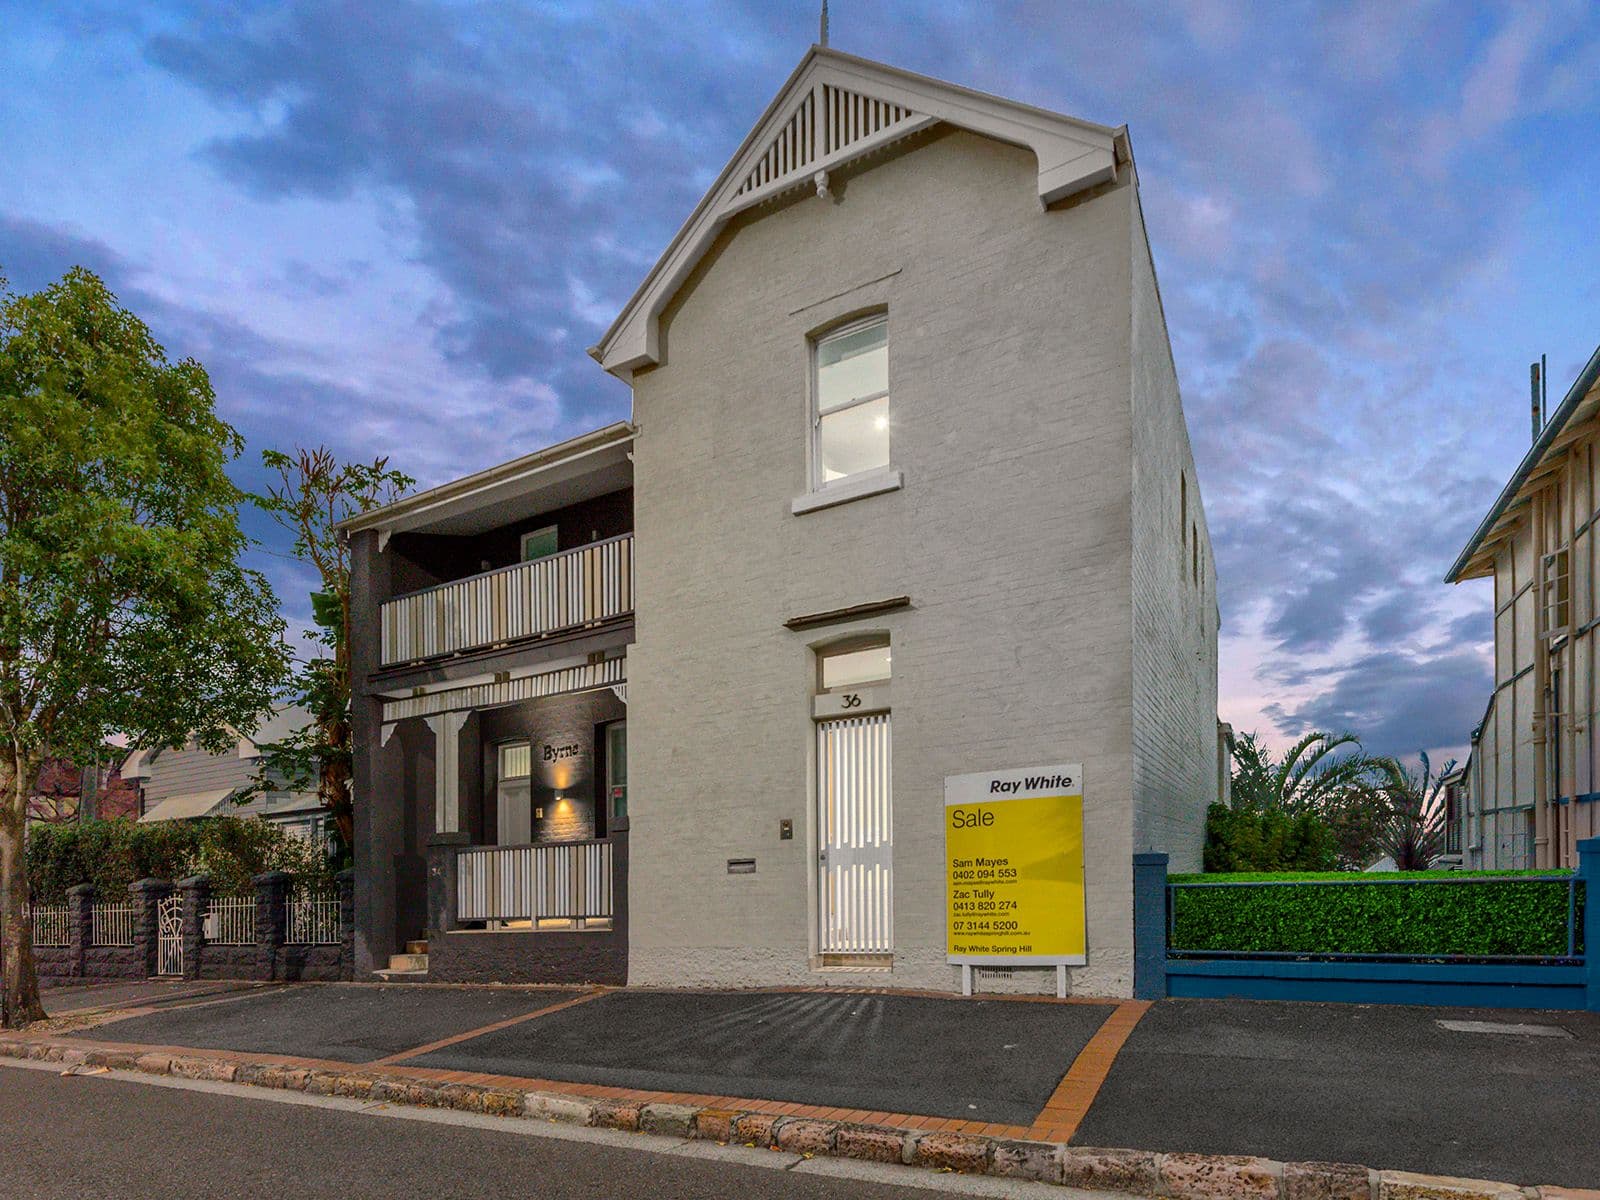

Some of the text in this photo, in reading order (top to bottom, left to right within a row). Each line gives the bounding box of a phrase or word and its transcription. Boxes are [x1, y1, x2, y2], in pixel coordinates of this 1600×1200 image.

[841, 693, 862, 709] 36
[543, 743, 579, 763] Byrne
[990, 775, 1073, 794] Ray White
[952, 808, 994, 828] Sale
[952, 858, 1009, 868] Sam Mayes
[952, 868, 1017, 880] 0402 094 553
[953, 889, 995, 900] Zac Tully
[953, 901, 1017, 911] 0413 820 274
[953, 920, 1018, 930] 07 3144 5200
[953, 945, 967, 953] Ray
[968, 945, 990, 953] White
[991, 945, 1017, 954] Spring
